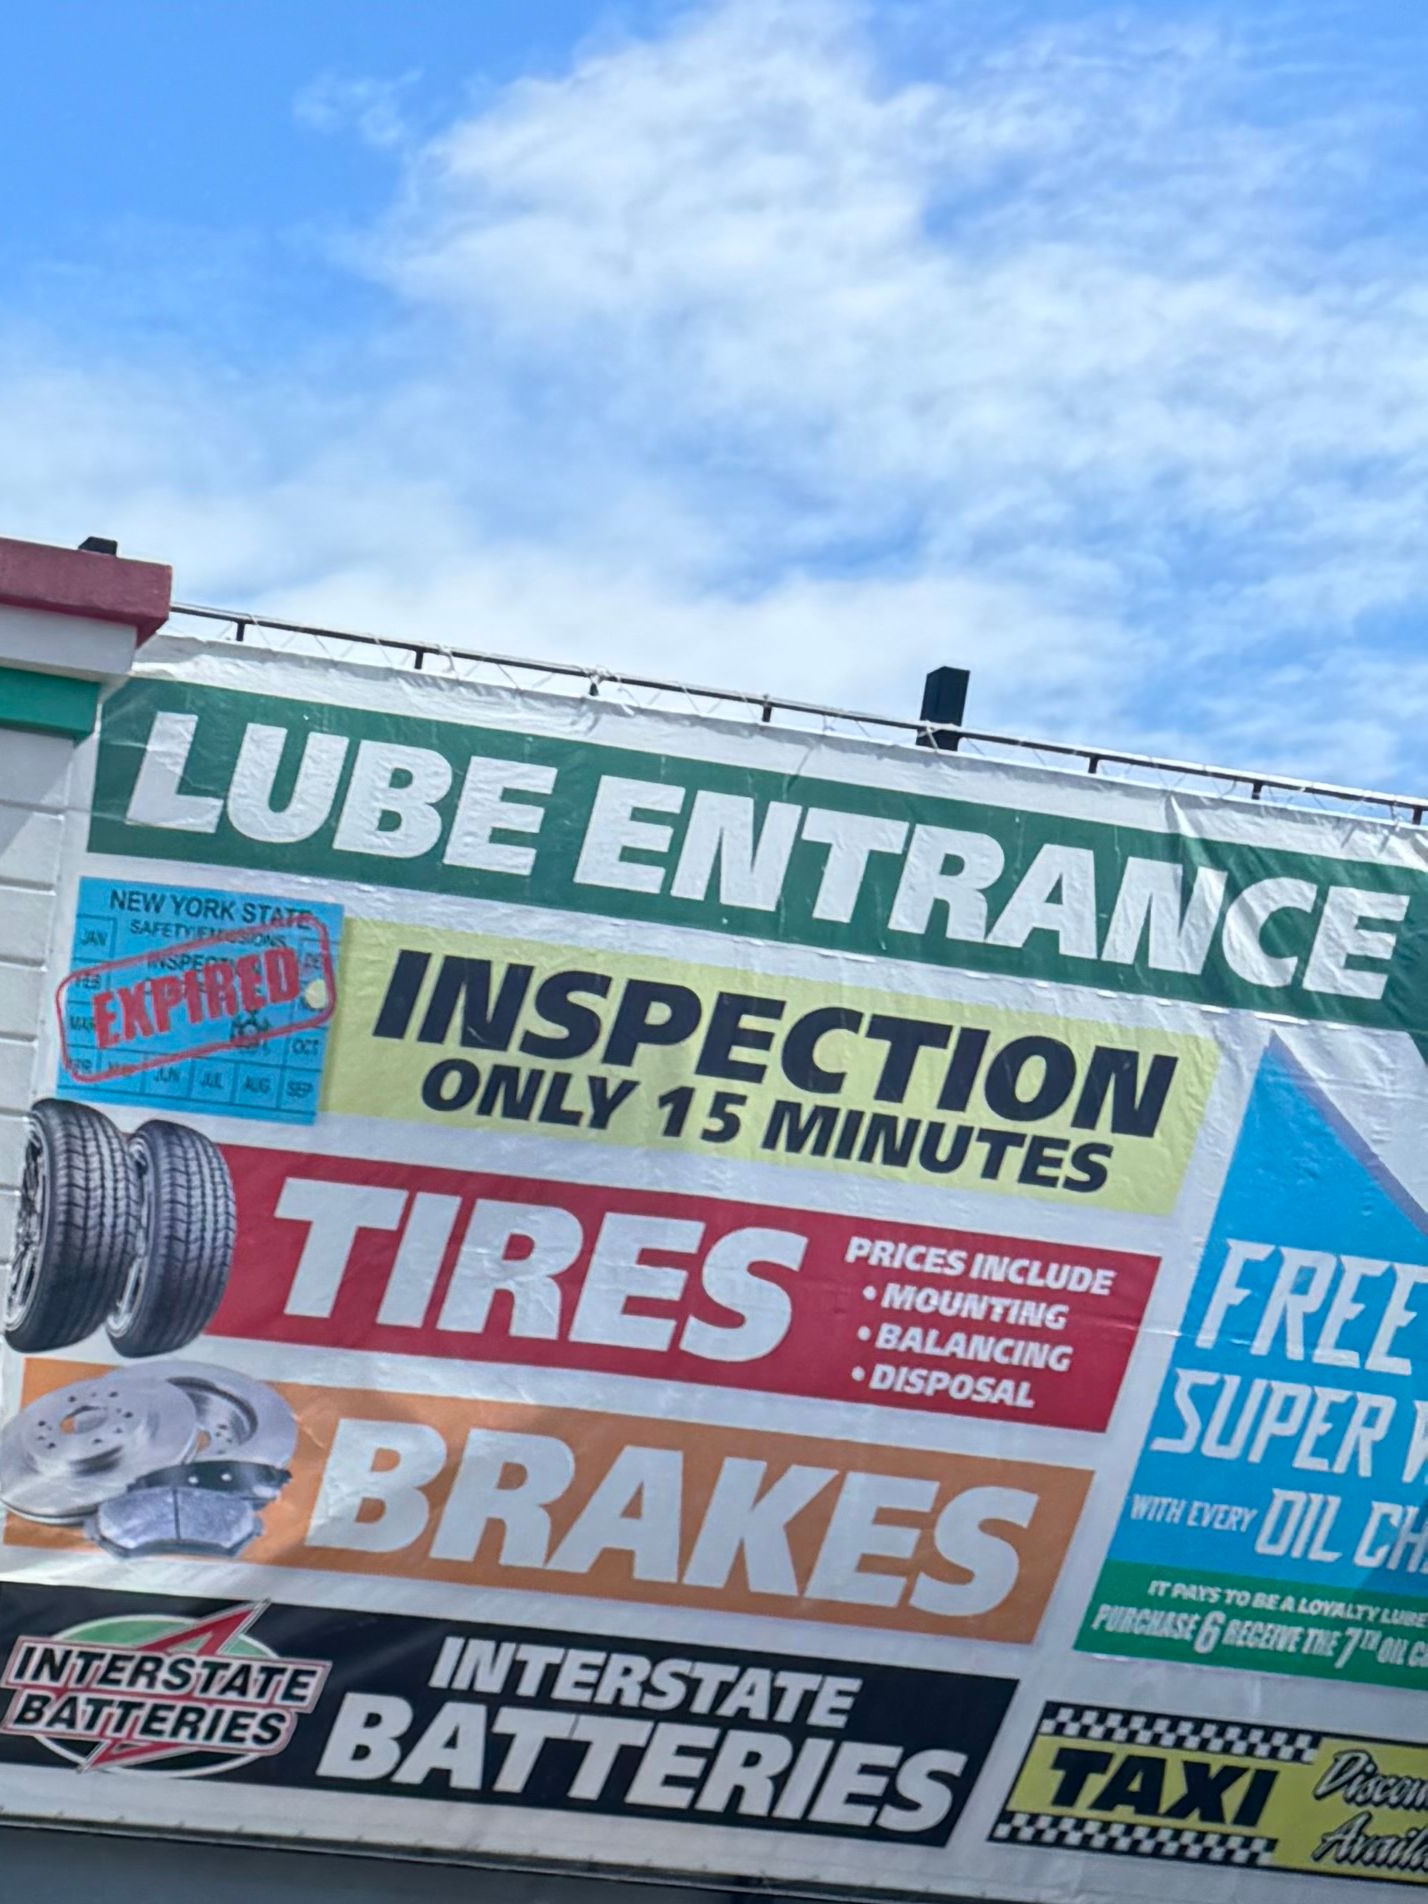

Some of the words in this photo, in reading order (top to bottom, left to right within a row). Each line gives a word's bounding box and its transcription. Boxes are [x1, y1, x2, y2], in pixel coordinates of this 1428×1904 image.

[126, 711, 557, 876] LUBE
[573, 774, 1410, 999] ENTRANCE
[110, 889, 165, 913] NEW
[170, 895, 235, 921] YORK
[241, 903, 313, 931] STATE
[92, 947, 300, 1050] EXPIRED
[373, 948, 1179, 1138] INSPECTION
[421, 1059, 642, 1130] ONLY
[658, 1087, 747, 1143] 15
[761, 1101, 1114, 1193] MINUTES
[274, 1177, 809, 1362] TIRES
[845, 1236, 967, 1276] PRICES
[969, 1253, 1117, 1296] INCLUDE
[881, 1283, 1069, 1330] MOUNTING
[1196, 1238, 1428, 1375] FREE
[869, 1364, 1035, 1408] DISPOSAL
[875, 1323, 1073, 1372] BALANCING
[1149, 1368, 1396, 1477] SUPER
[304, 1418, 1040, 1616] BRAKES
[1130, 1495, 1185, 1524] WITH
[1187, 1503, 1258, 1532] EVERY
[1254, 1488, 1343, 1562] OIL
[1092, 1604, 1201, 1641] PURCHASE
[1194, 1610, 1226, 1654] 6
[1222, 1619, 1304, 1653] RECEIVE
[1302, 1628, 1342, 1657] THE
[1147, 1580, 1172, 1596] IT
[1171, 1583, 1221, 1603] PAYS
[1224, 1588, 1251, 1607] TO
[1252, 1592, 1280, 1609] BE
[1280, 1596, 1295, 1613] A
[1297, 1598, 1380, 1622] LOYALTY
[14, 1646, 317, 1703] INTERSTATE
[429, 1637, 862, 1728] INTERSTATE
[13, 1694, 287, 1745] BATTERIES
[315, 1691, 967, 1833] BATTERIES
[1050, 1747, 1279, 1828] TAXI
